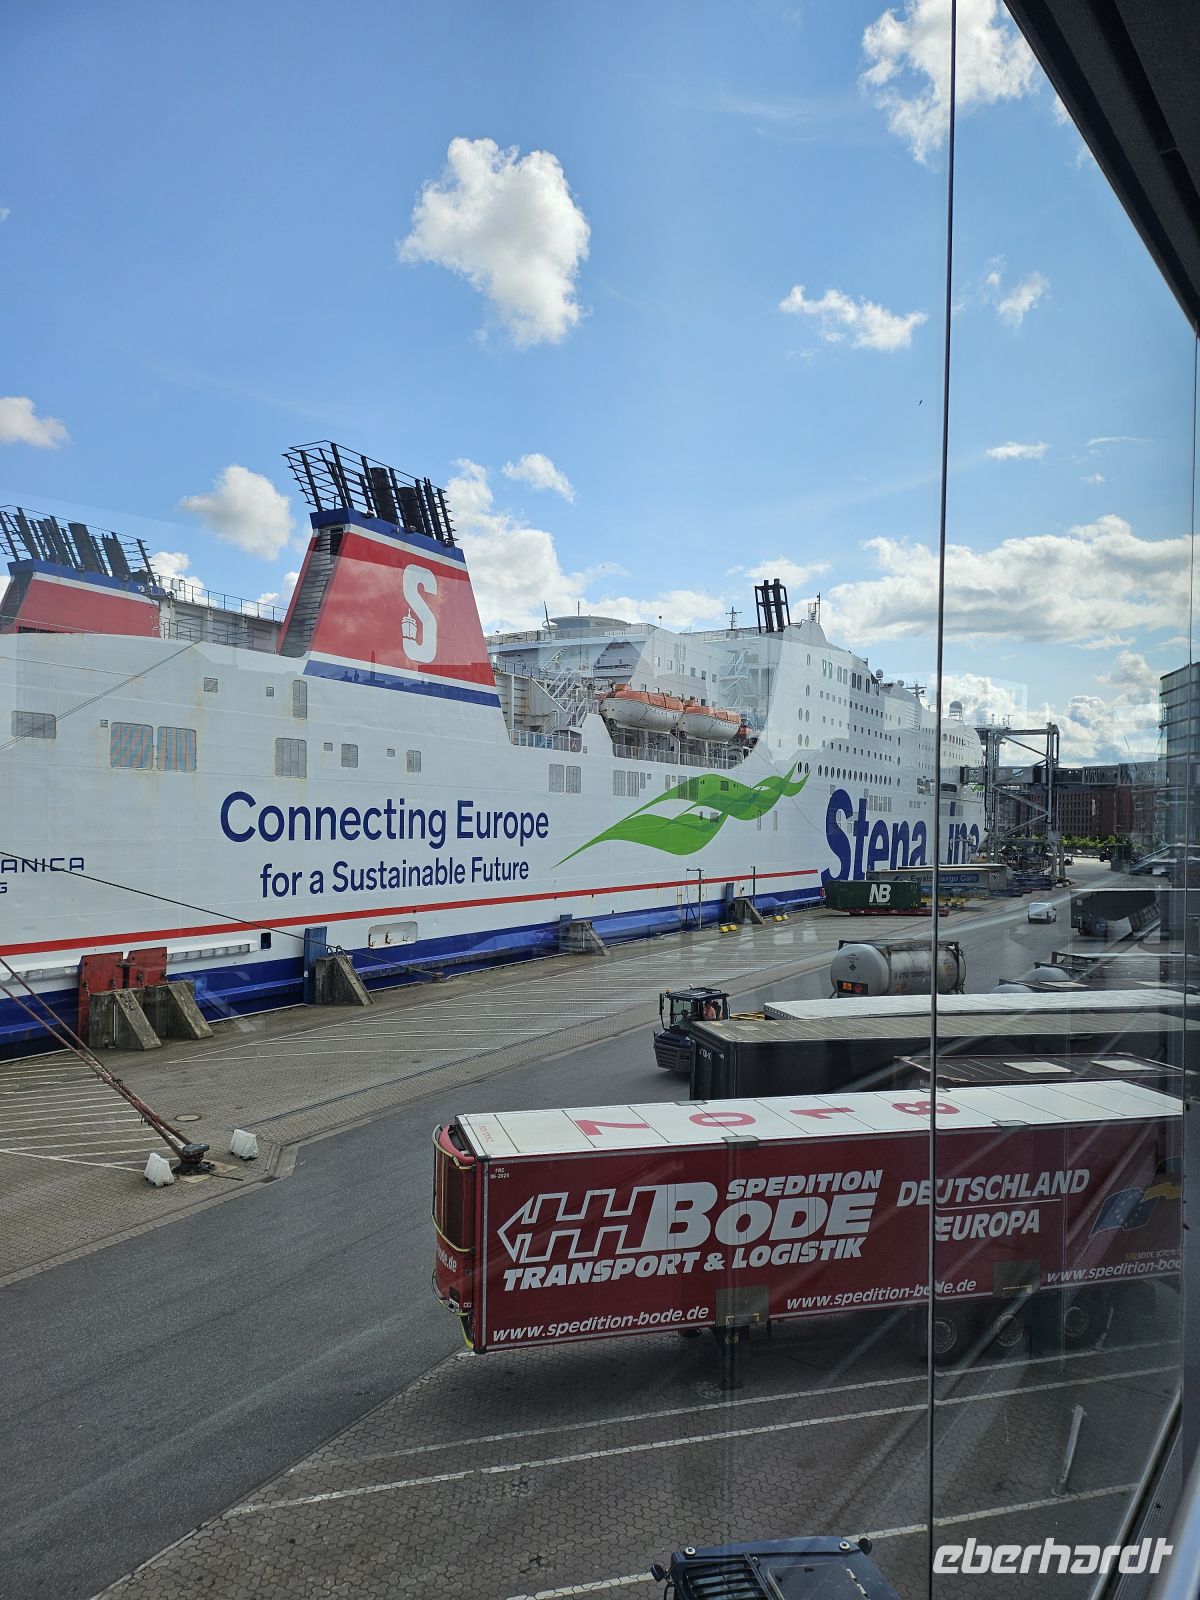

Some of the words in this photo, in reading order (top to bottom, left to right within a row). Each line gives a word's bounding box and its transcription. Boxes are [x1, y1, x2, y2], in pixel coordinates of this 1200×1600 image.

[403, 564, 437, 663] S
[220, 790, 447, 850] Connecting
[457, 800, 549, 847] Europe
[821, 788, 927, 887] Stena
[946, 802, 980, 864] ine
[259, 863, 303, 898] for
[309, 869, 324, 894] a
[332, 857, 466, 893] Sustainable
[471, 856, 530, 883] Future
[869, 884, 891, 902] NB
[725, 1169, 884, 1200] SPEDITION
[896, 1169, 1090, 1207] DEUTSCHLAND
[640, 1181, 878, 1253] BODE
[935, 1208, 1040, 1242] EUROPA
[503, 1251, 701, 1292] TRANSPORT
[703, 1252, 726, 1272] &
[731, 1237, 867, 1269] LOGISTIK
[493, 1305, 709, 1342] www.spedition-bode.de
